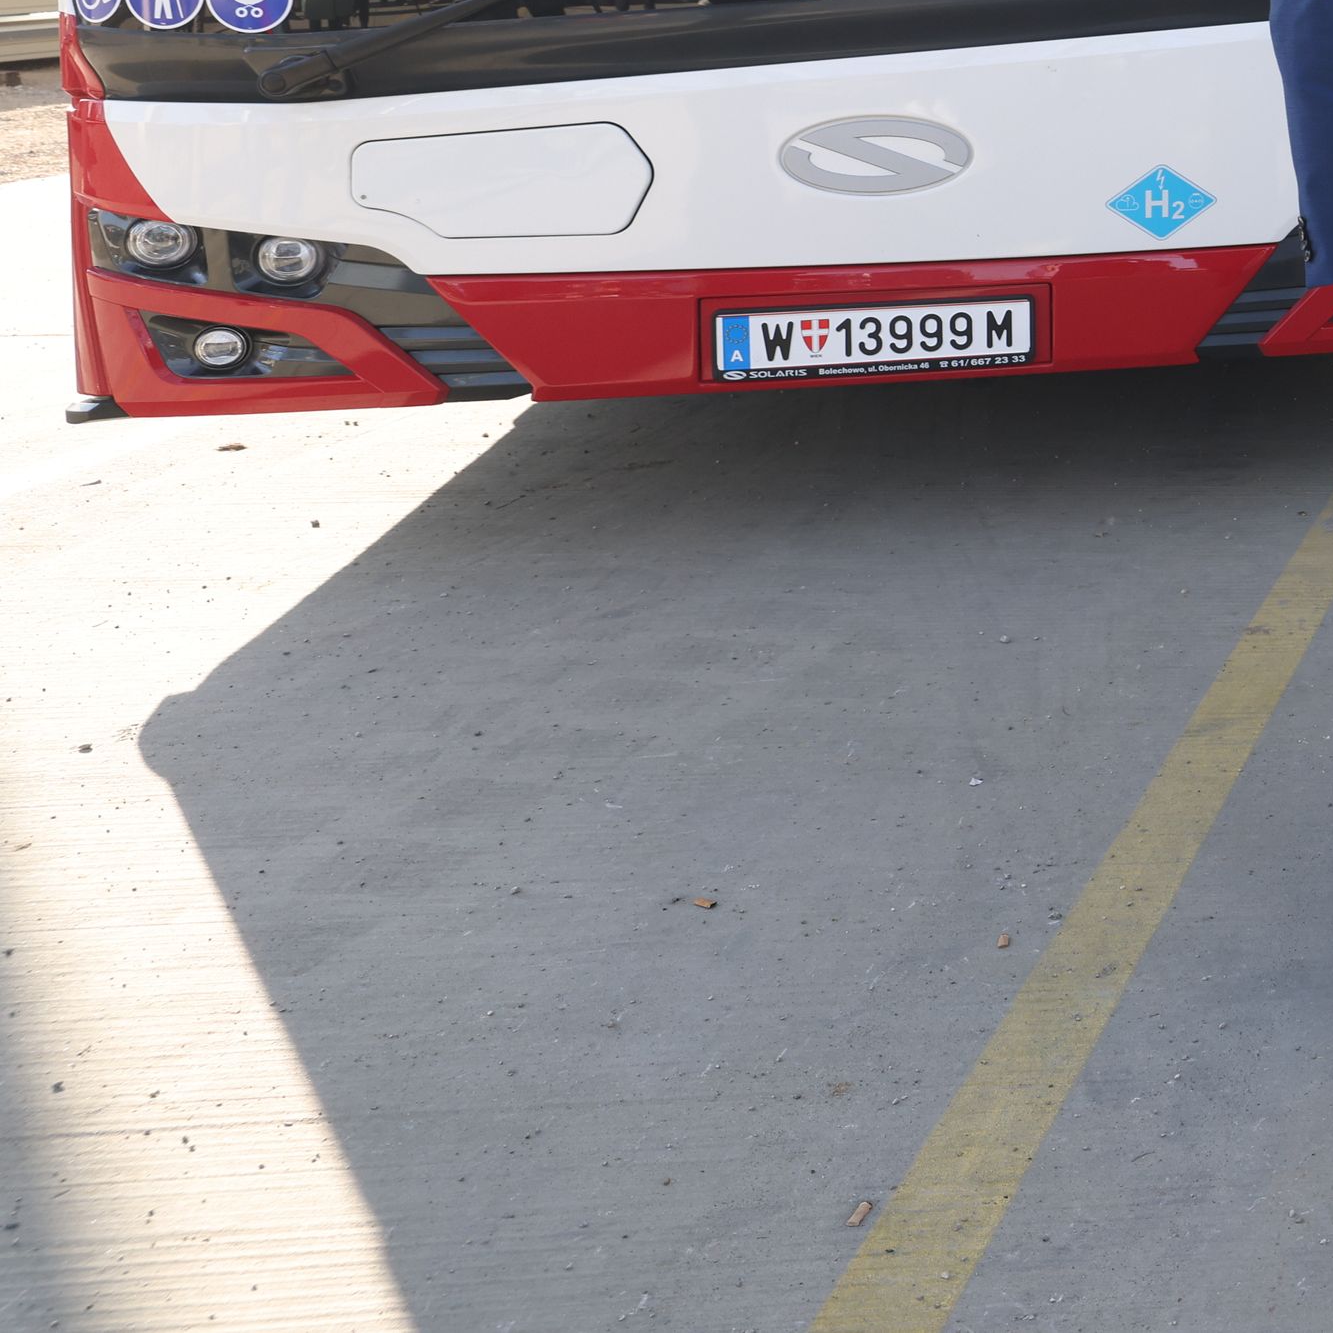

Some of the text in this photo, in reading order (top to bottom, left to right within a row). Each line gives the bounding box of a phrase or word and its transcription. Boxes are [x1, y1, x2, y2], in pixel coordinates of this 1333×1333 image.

[761, 321, 794, 362] W
[730, 349, 744, 363] A
[749, 368, 808, 379] SOLARIS
[818, 365, 867, 376] Bolechowo,
[878, 362, 918, 372] Obornicka
[970, 357, 992, 366] 667
[994, 355, 1009, 364] 23
[1011, 354, 1026, 363] 33
